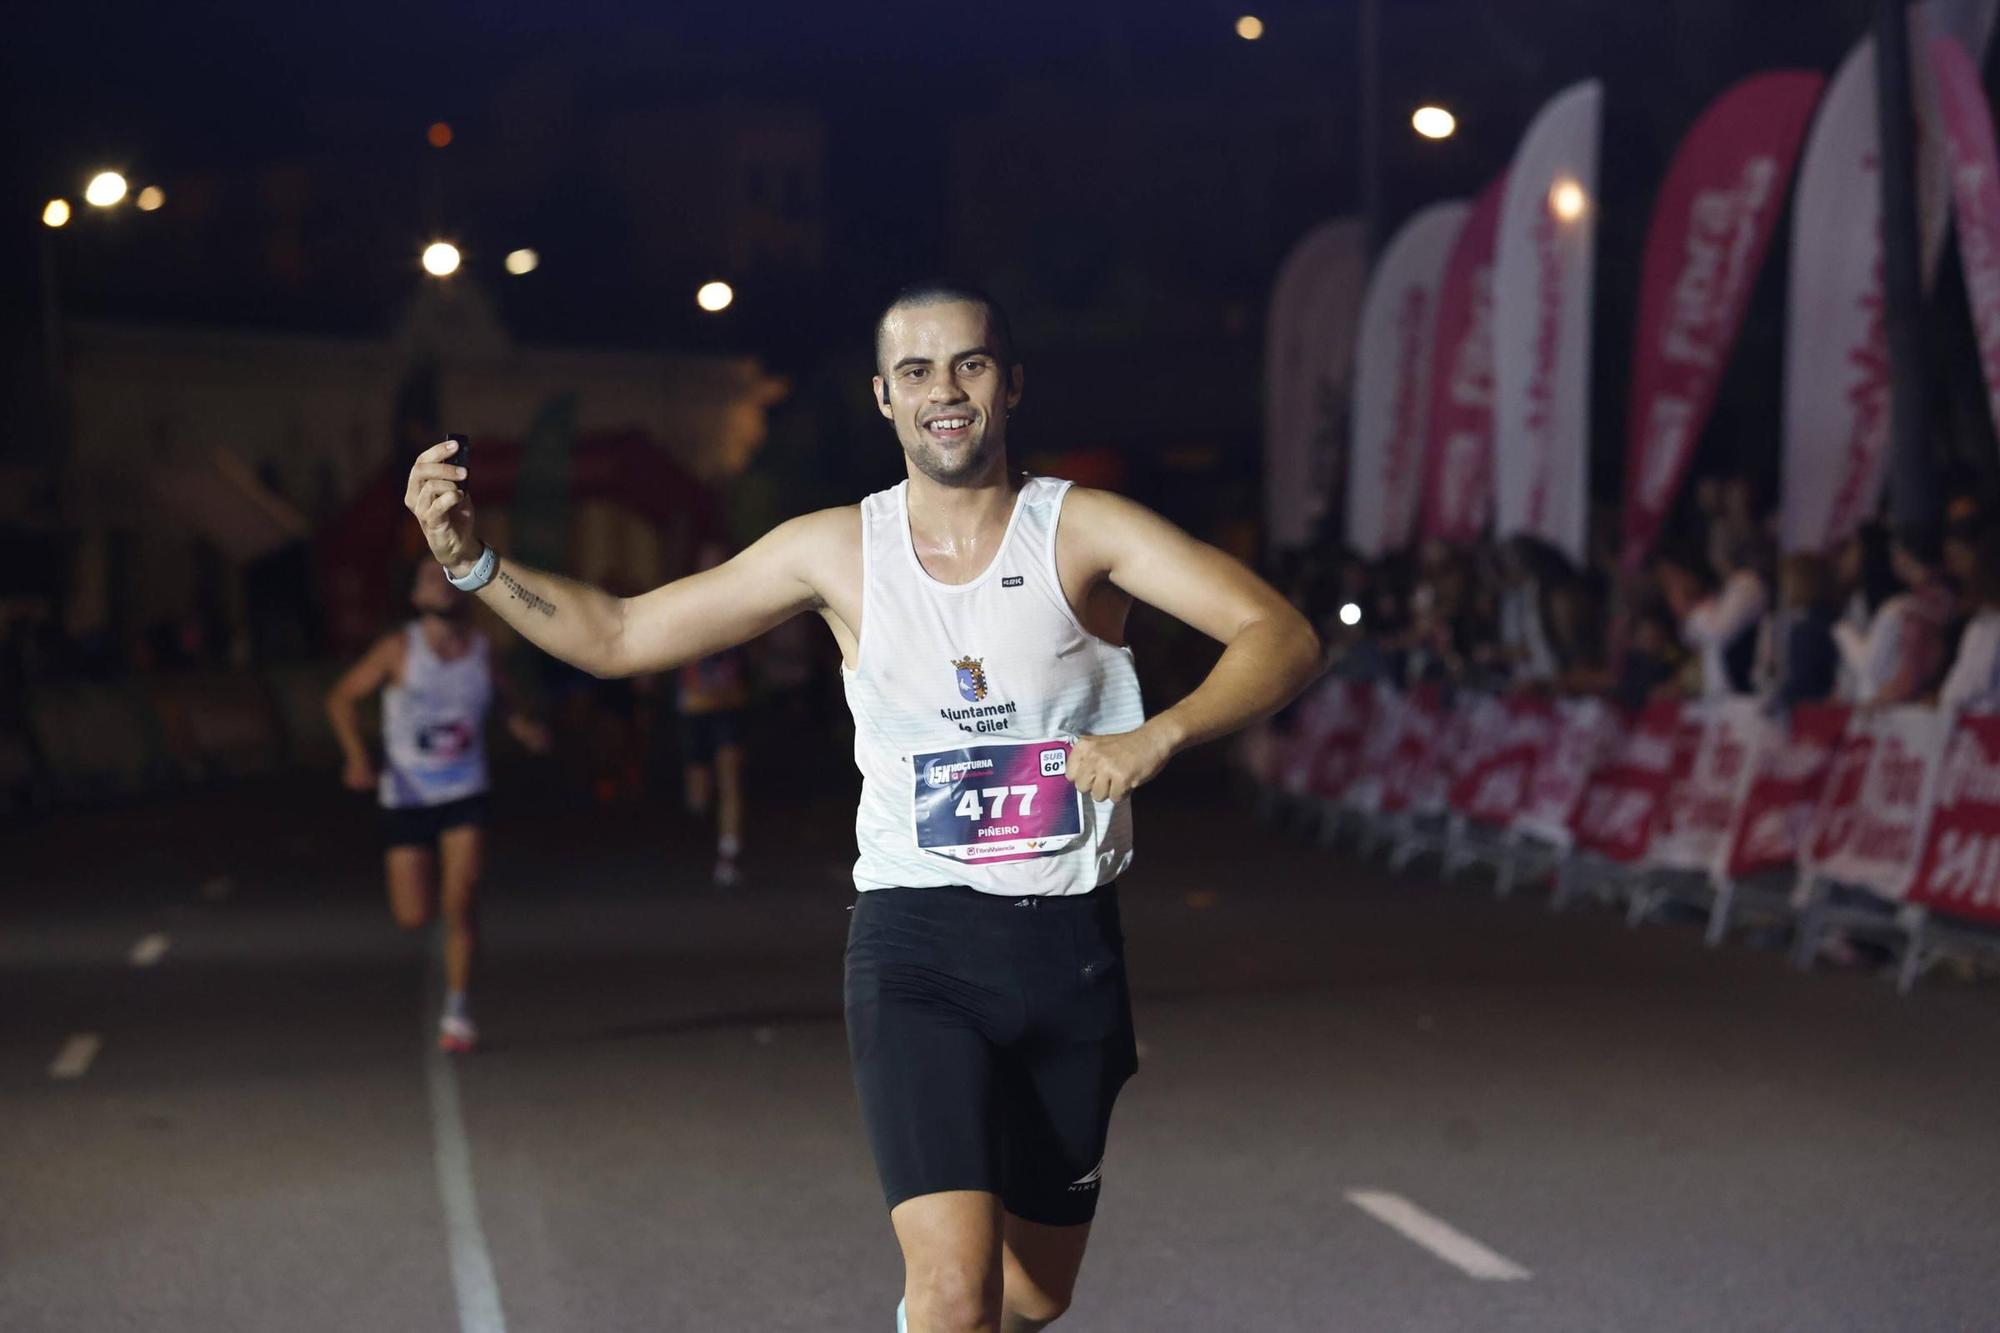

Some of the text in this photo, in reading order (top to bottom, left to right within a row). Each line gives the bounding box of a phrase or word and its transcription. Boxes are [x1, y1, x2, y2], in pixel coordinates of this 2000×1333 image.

[941, 701, 1016, 720] Ajuntament
[977, 718, 1008, 732] Gilet
[1043, 752, 1063, 761] SUB
[951, 759, 993, 772] NOCTURNA
[955, 784, 1038, 821] 477
[978, 826, 1019, 837] PIÑEIRO
